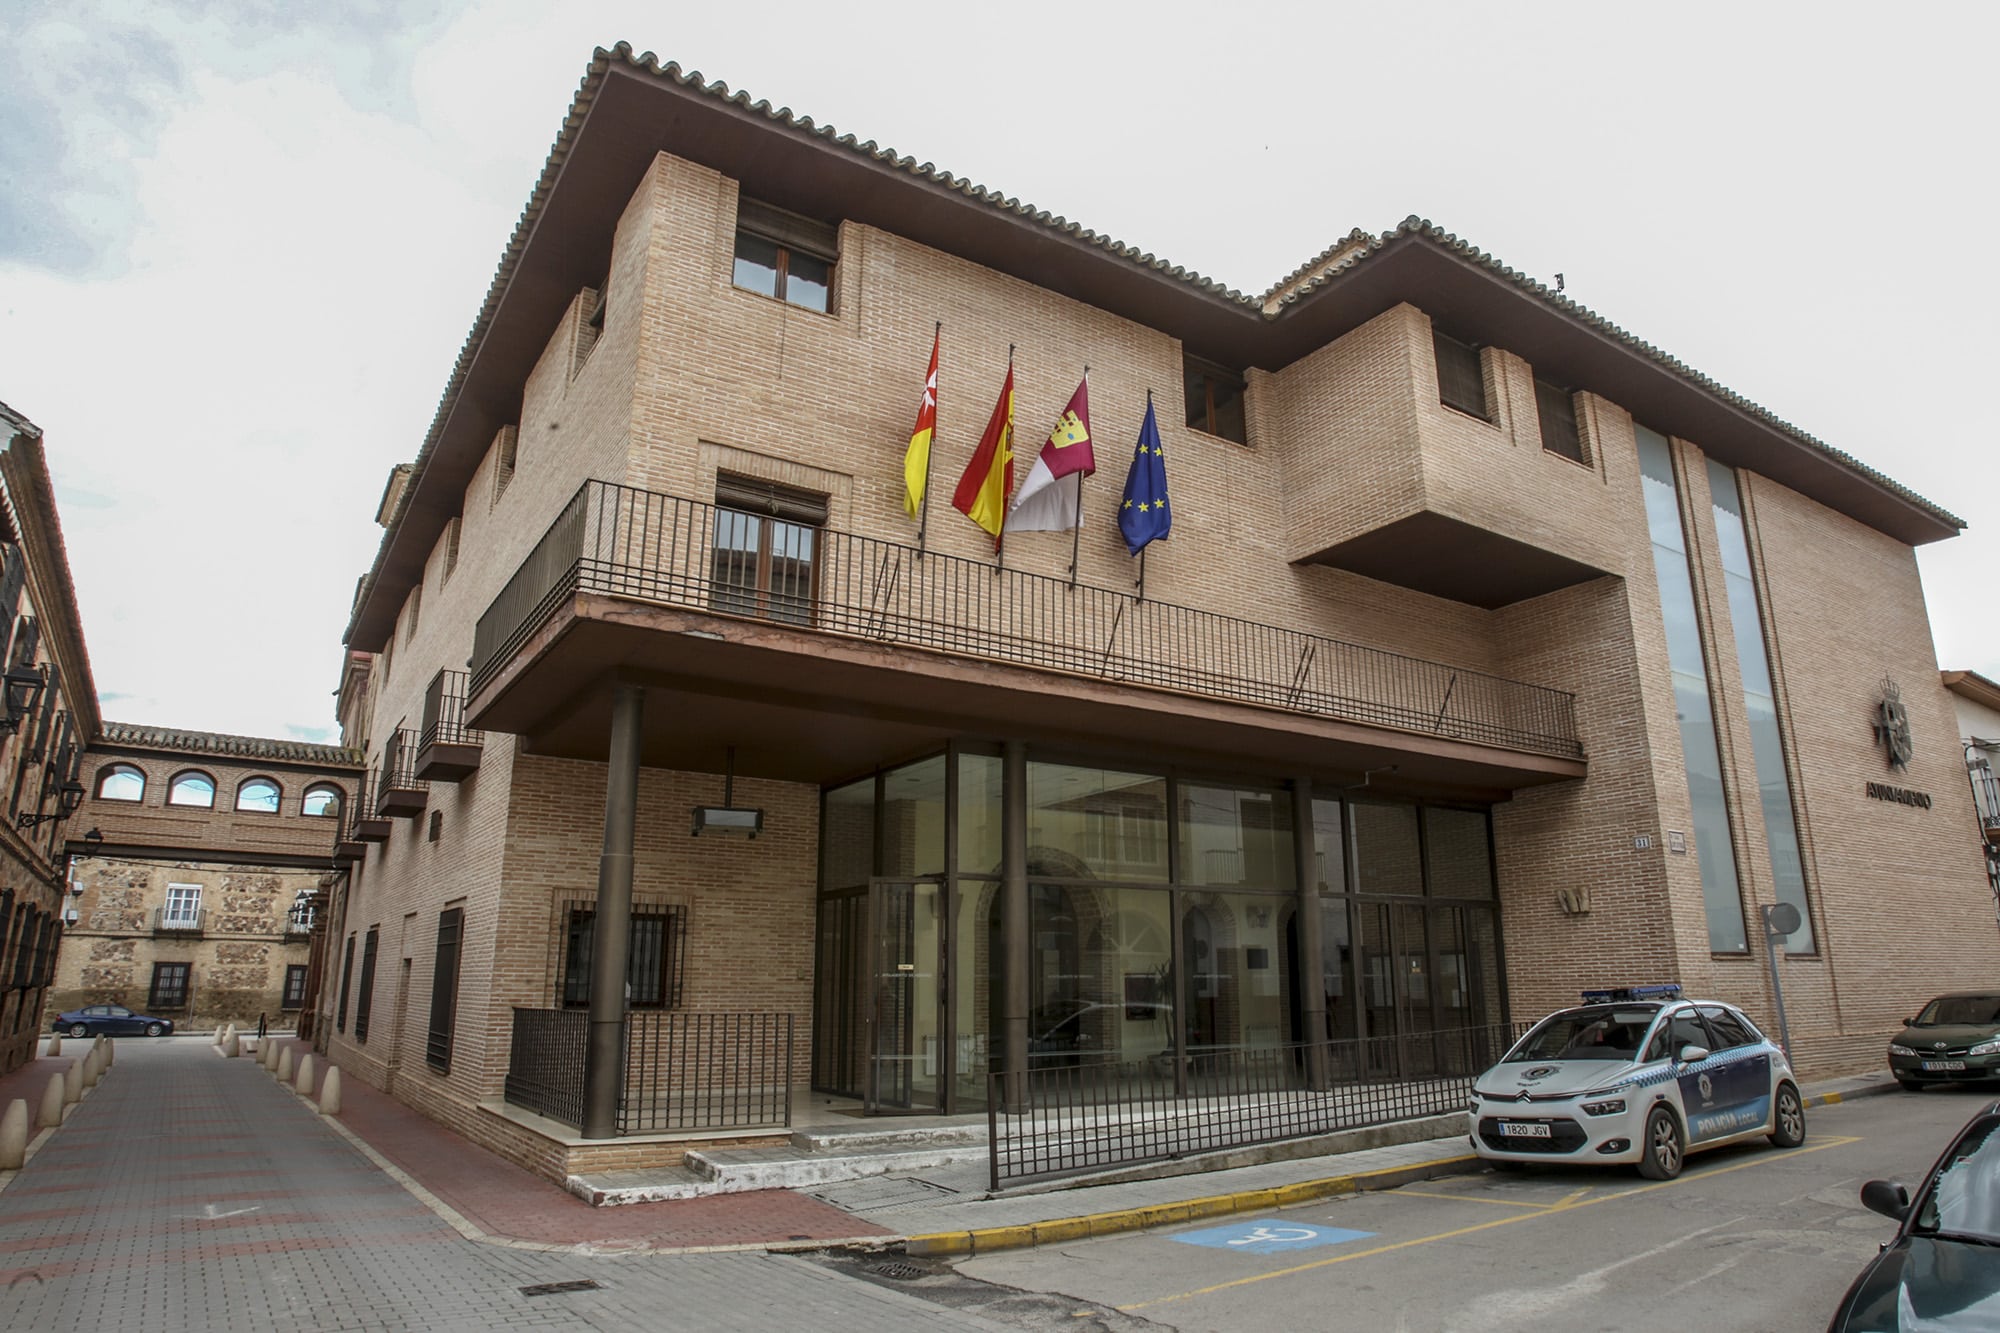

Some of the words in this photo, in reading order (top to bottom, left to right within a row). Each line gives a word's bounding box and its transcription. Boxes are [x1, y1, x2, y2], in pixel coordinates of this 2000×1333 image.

[1866, 781, 1932, 810] AYUNTAMIENTO
[1637, 839, 1646, 847] 31
[1738, 1112, 1759, 1126] LOCAL
[1507, 1125, 1528, 1135] 1820
[1532, 1126, 1547, 1135] JGV
